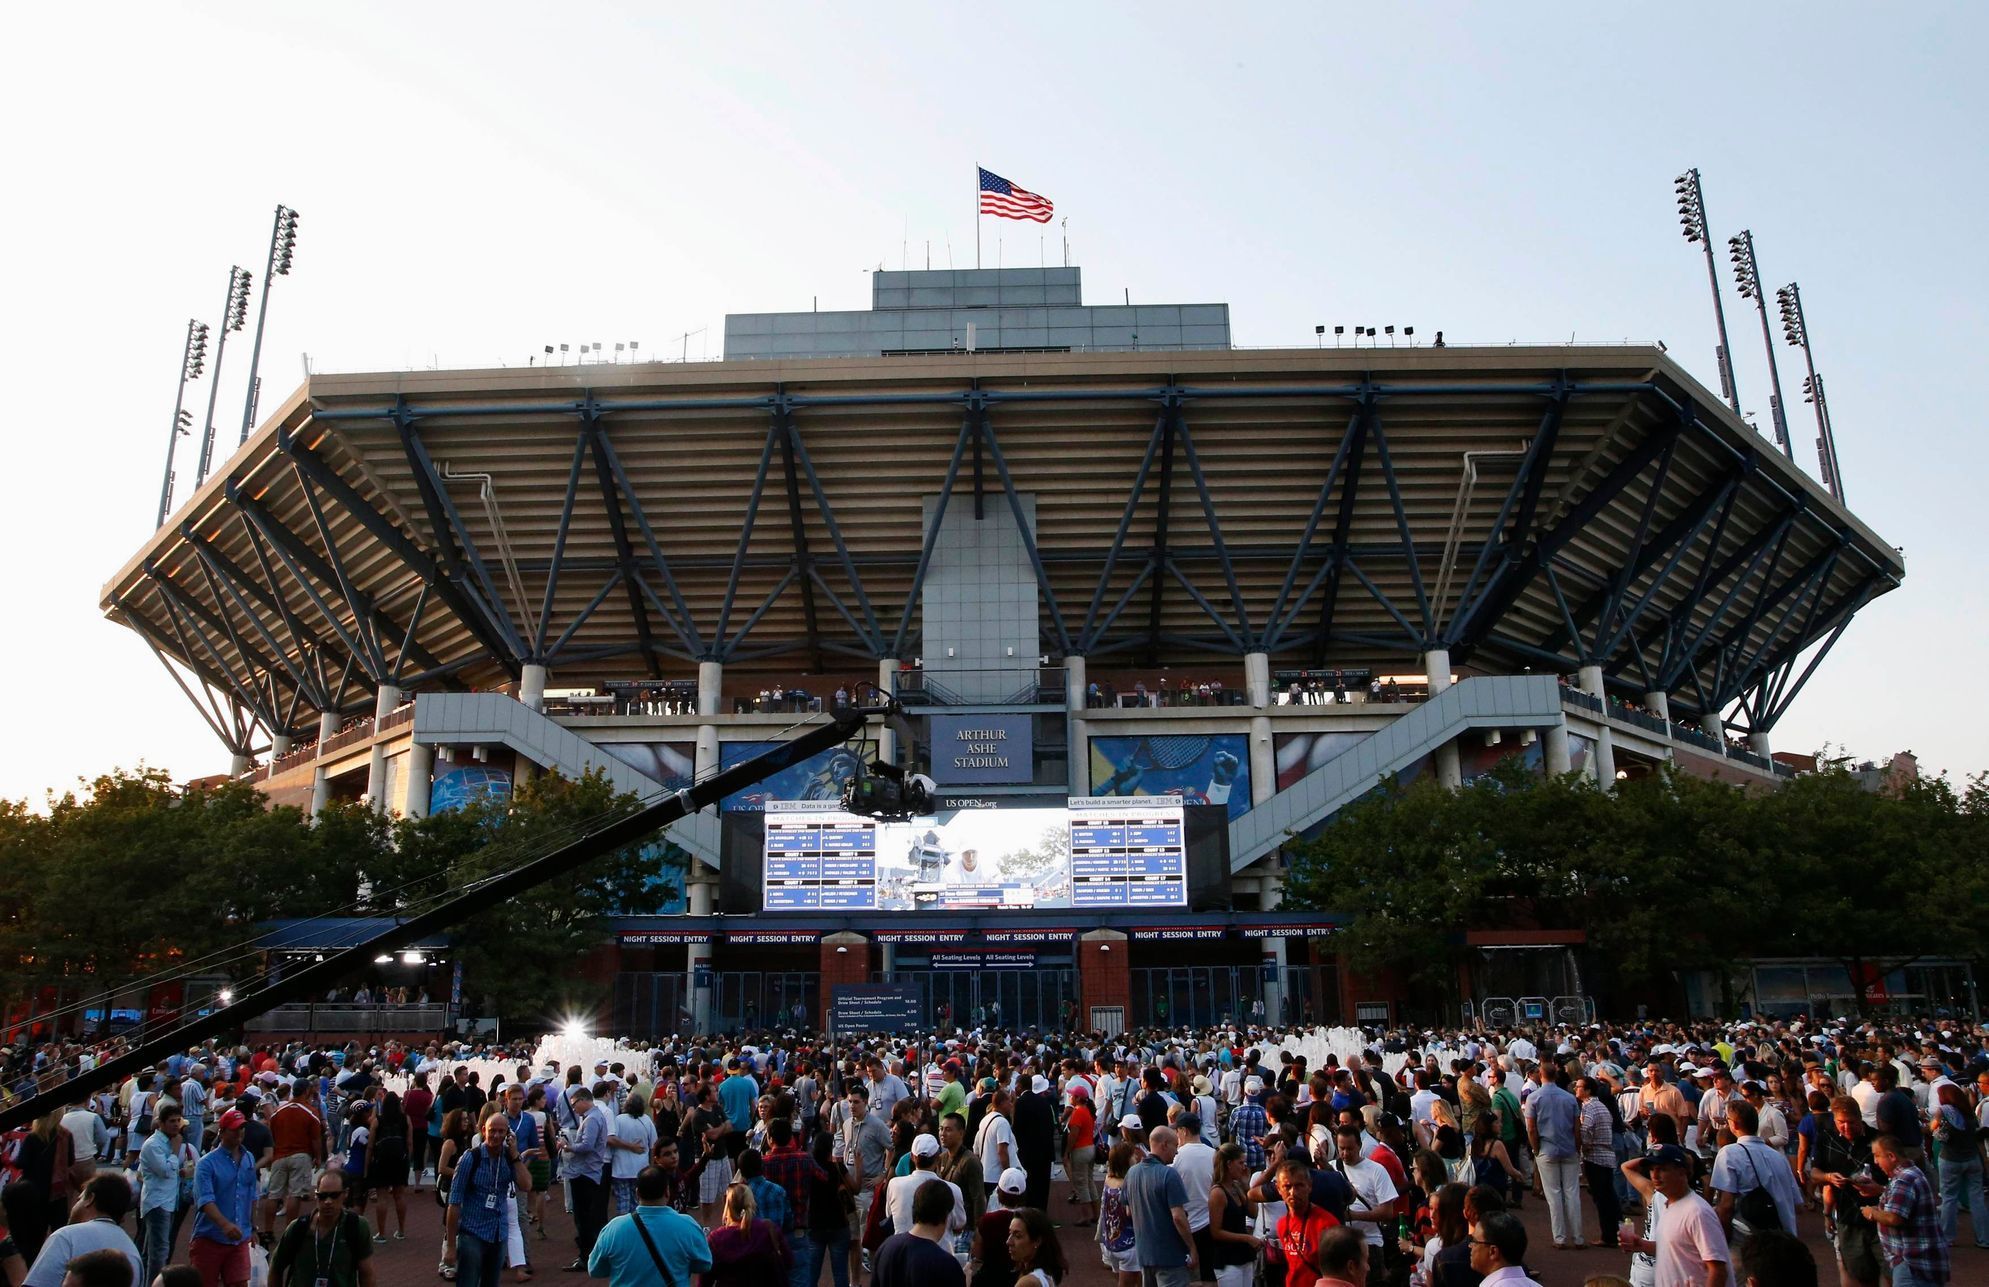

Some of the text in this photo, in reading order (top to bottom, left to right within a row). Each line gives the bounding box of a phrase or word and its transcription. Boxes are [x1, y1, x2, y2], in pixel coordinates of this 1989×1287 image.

[956, 730, 1006, 740] ARTHUR
[966, 744, 997, 753] ASHE
[954, 758, 1008, 768] STADIUM
[946, 799, 957, 807] US
